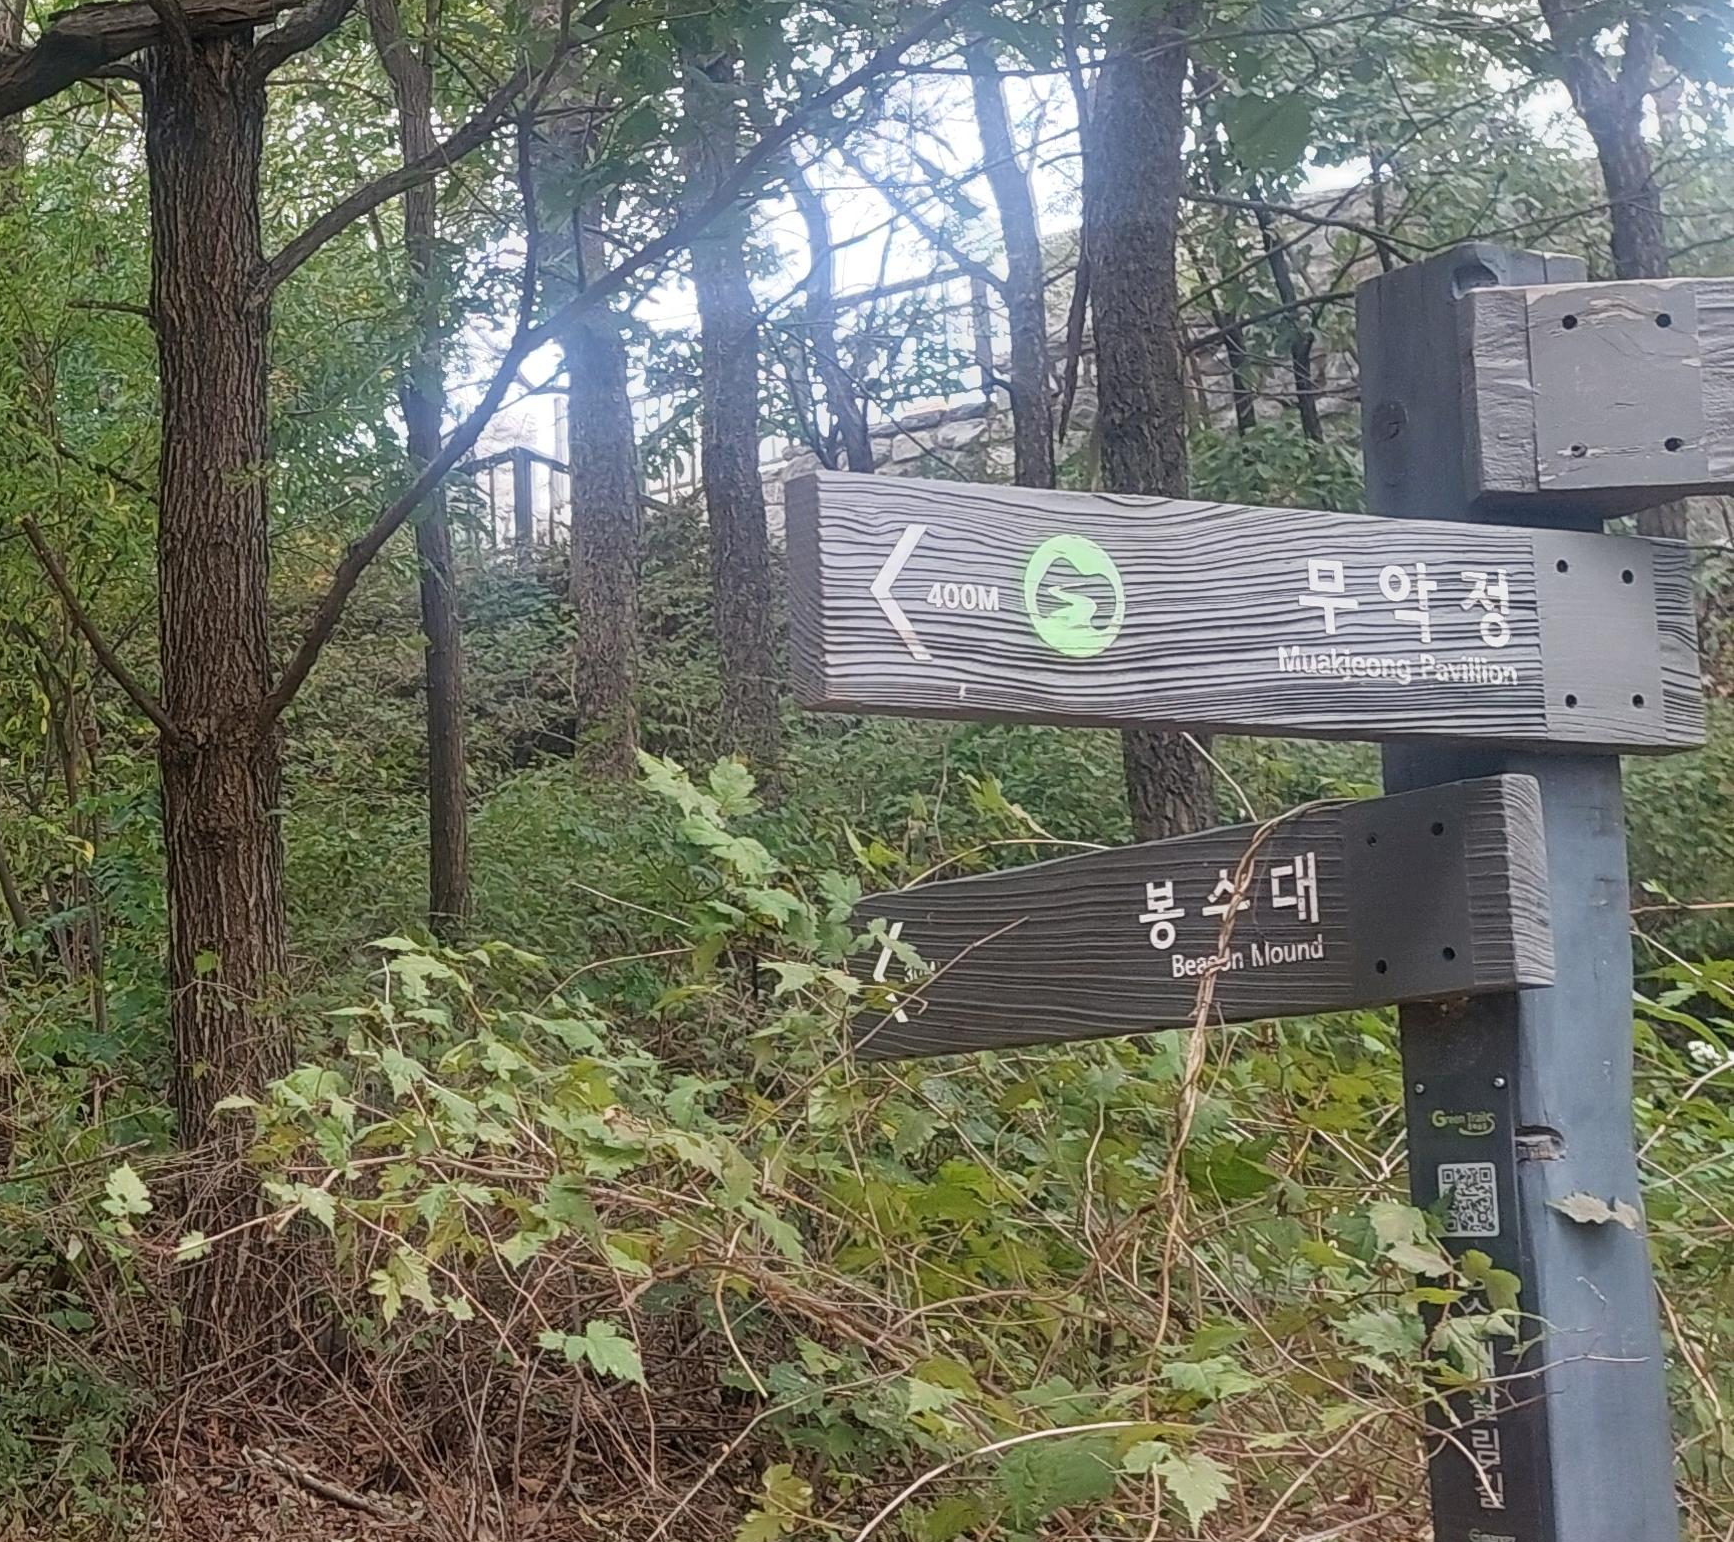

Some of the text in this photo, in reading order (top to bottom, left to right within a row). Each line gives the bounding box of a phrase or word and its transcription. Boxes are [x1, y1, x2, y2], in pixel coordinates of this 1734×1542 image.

[926, 582, 1000, 612] 400M
[1298, 558, 1513, 648] 무악정
[1277, 645, 1412, 685] Muakjeong
[1138, 851, 1320, 950] 봉수대
[1251, 933, 1324, 967] Mound
